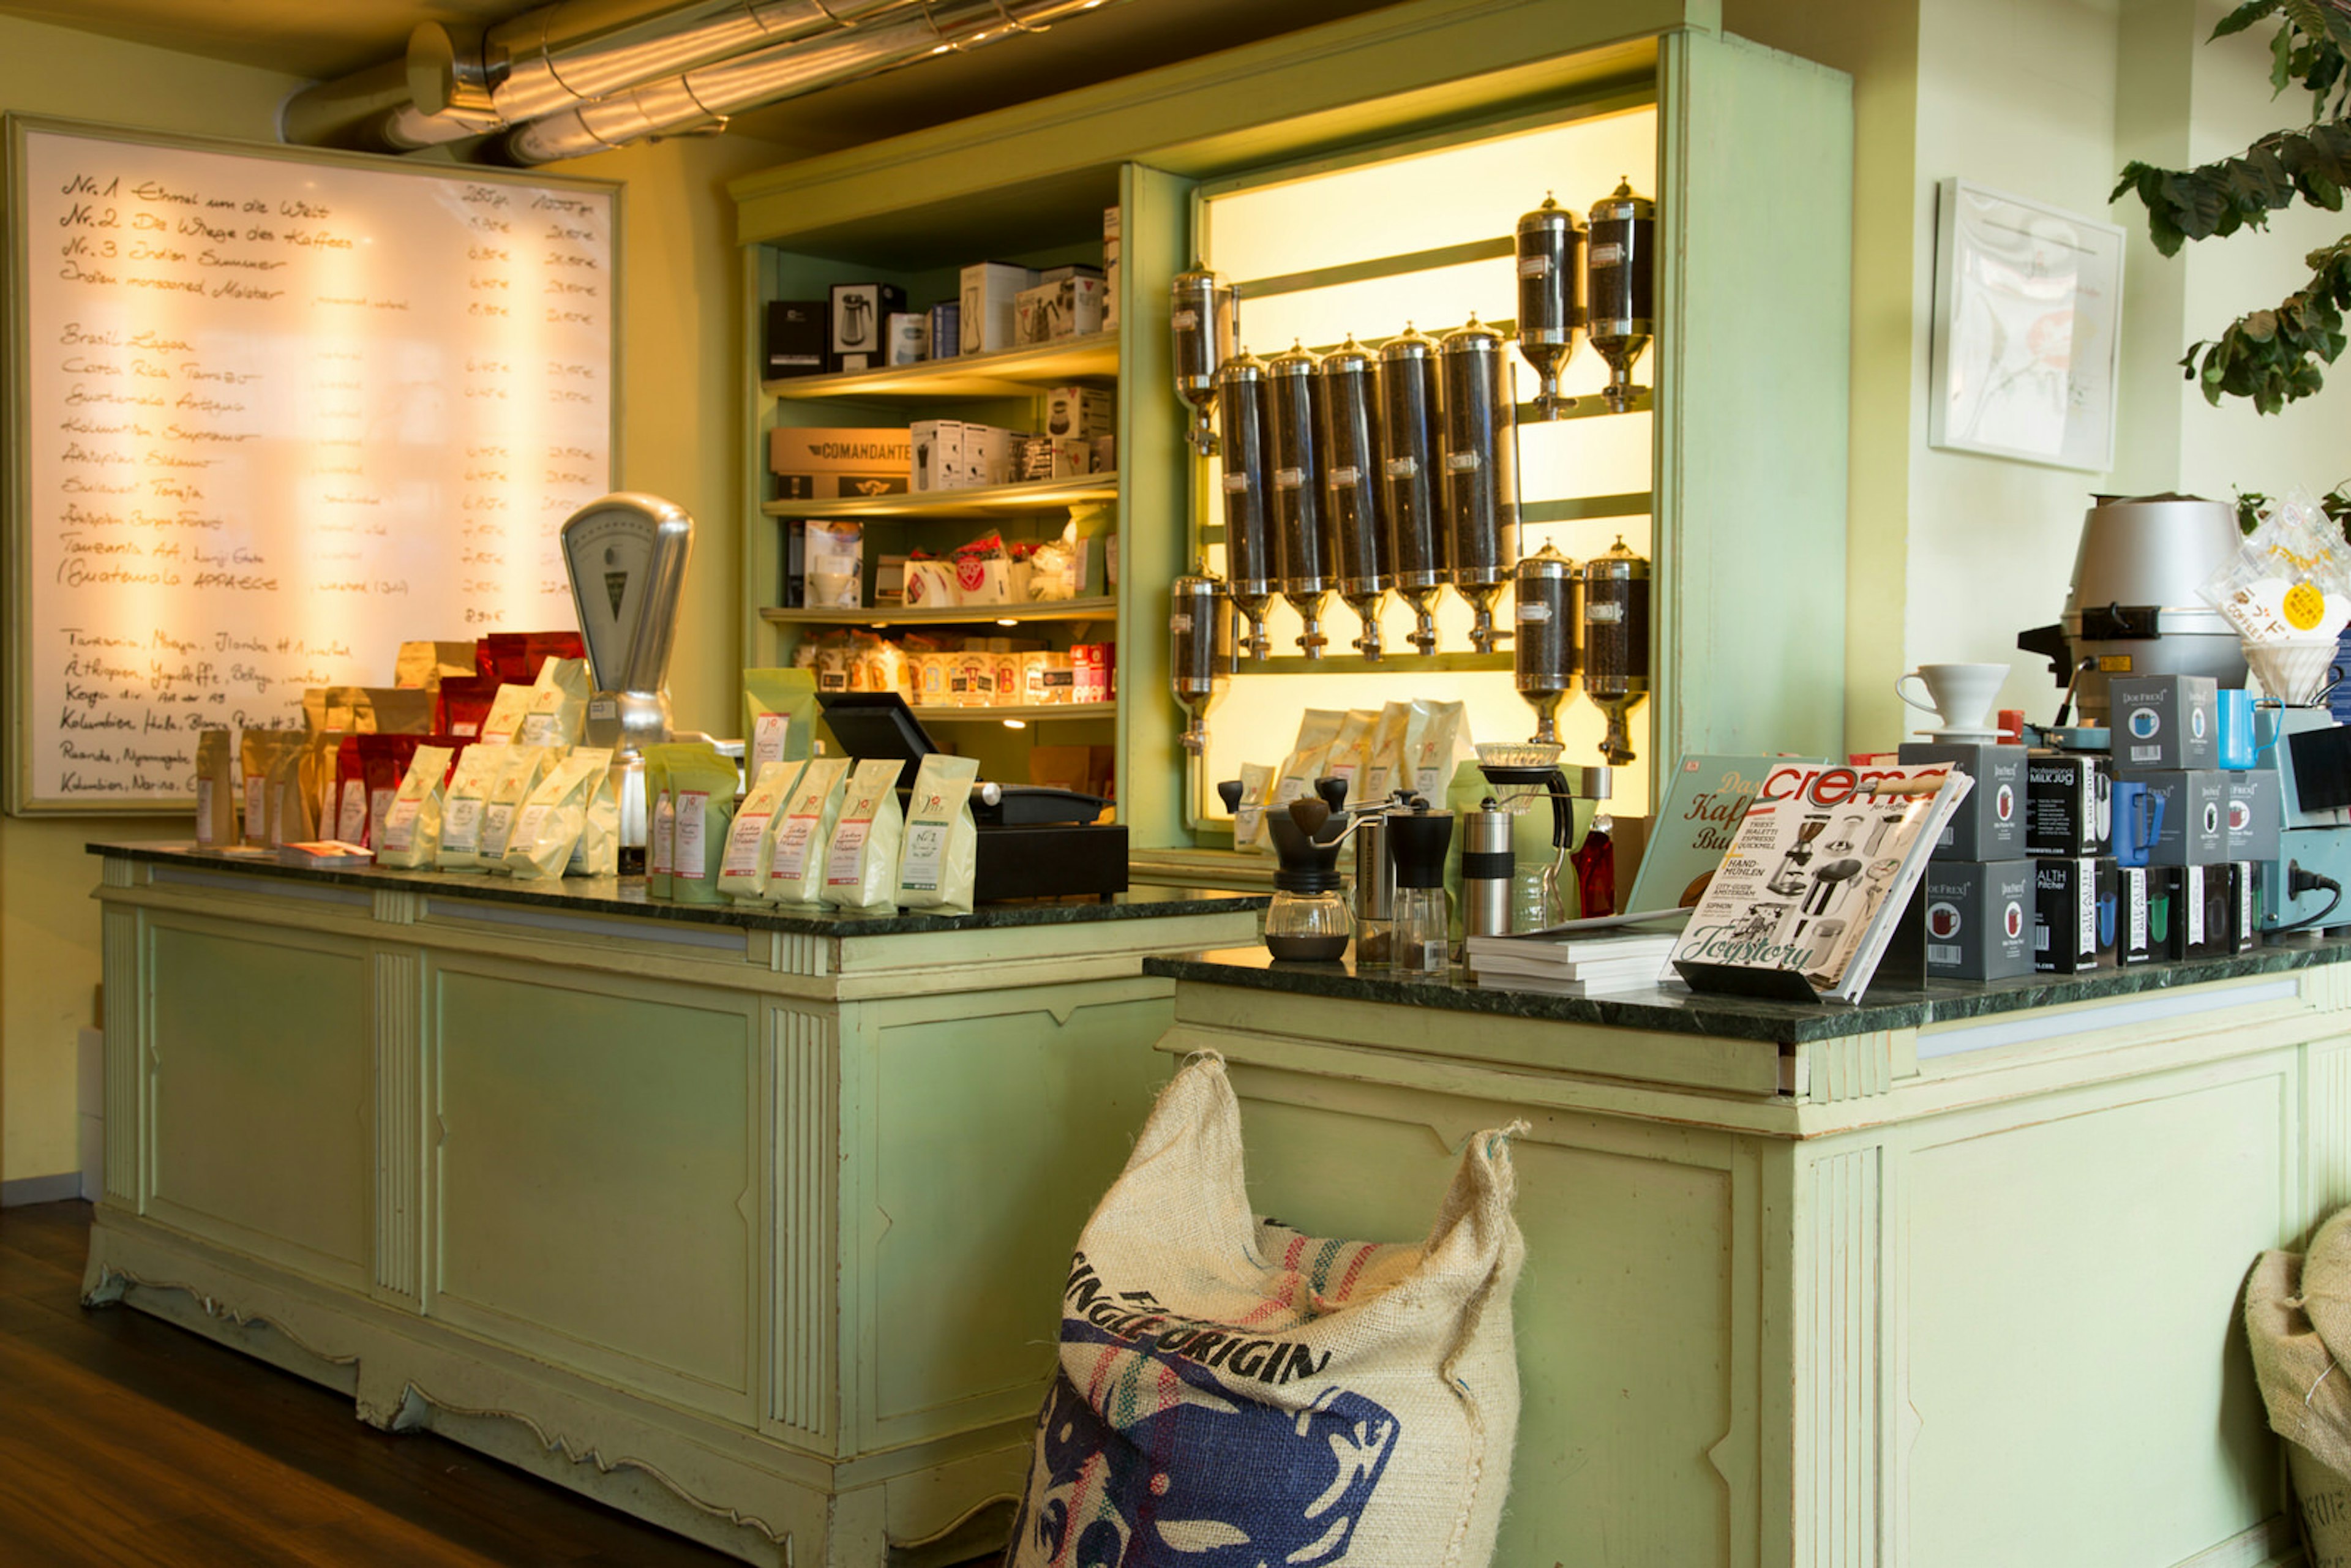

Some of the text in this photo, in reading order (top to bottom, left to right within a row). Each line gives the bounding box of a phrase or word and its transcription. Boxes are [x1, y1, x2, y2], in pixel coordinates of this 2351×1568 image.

[104, 177, 118, 198] 1
[279, 200, 331, 219] Welt
[97, 207, 122, 228] 2
[100, 241, 118, 258] 3
[197, 249, 288, 269] Summer
[60, 322, 122, 347] Brasil
[131, 359, 170, 379] Rica
[822, 442, 911, 460] COMANDANTE
[1716, 770, 1761, 795] Das
[1723, 868, 1765, 877] MÜHLEN
[1728, 859, 1760, 868] HAND-
[1156, 1326, 1332, 1385] ORIGIN
